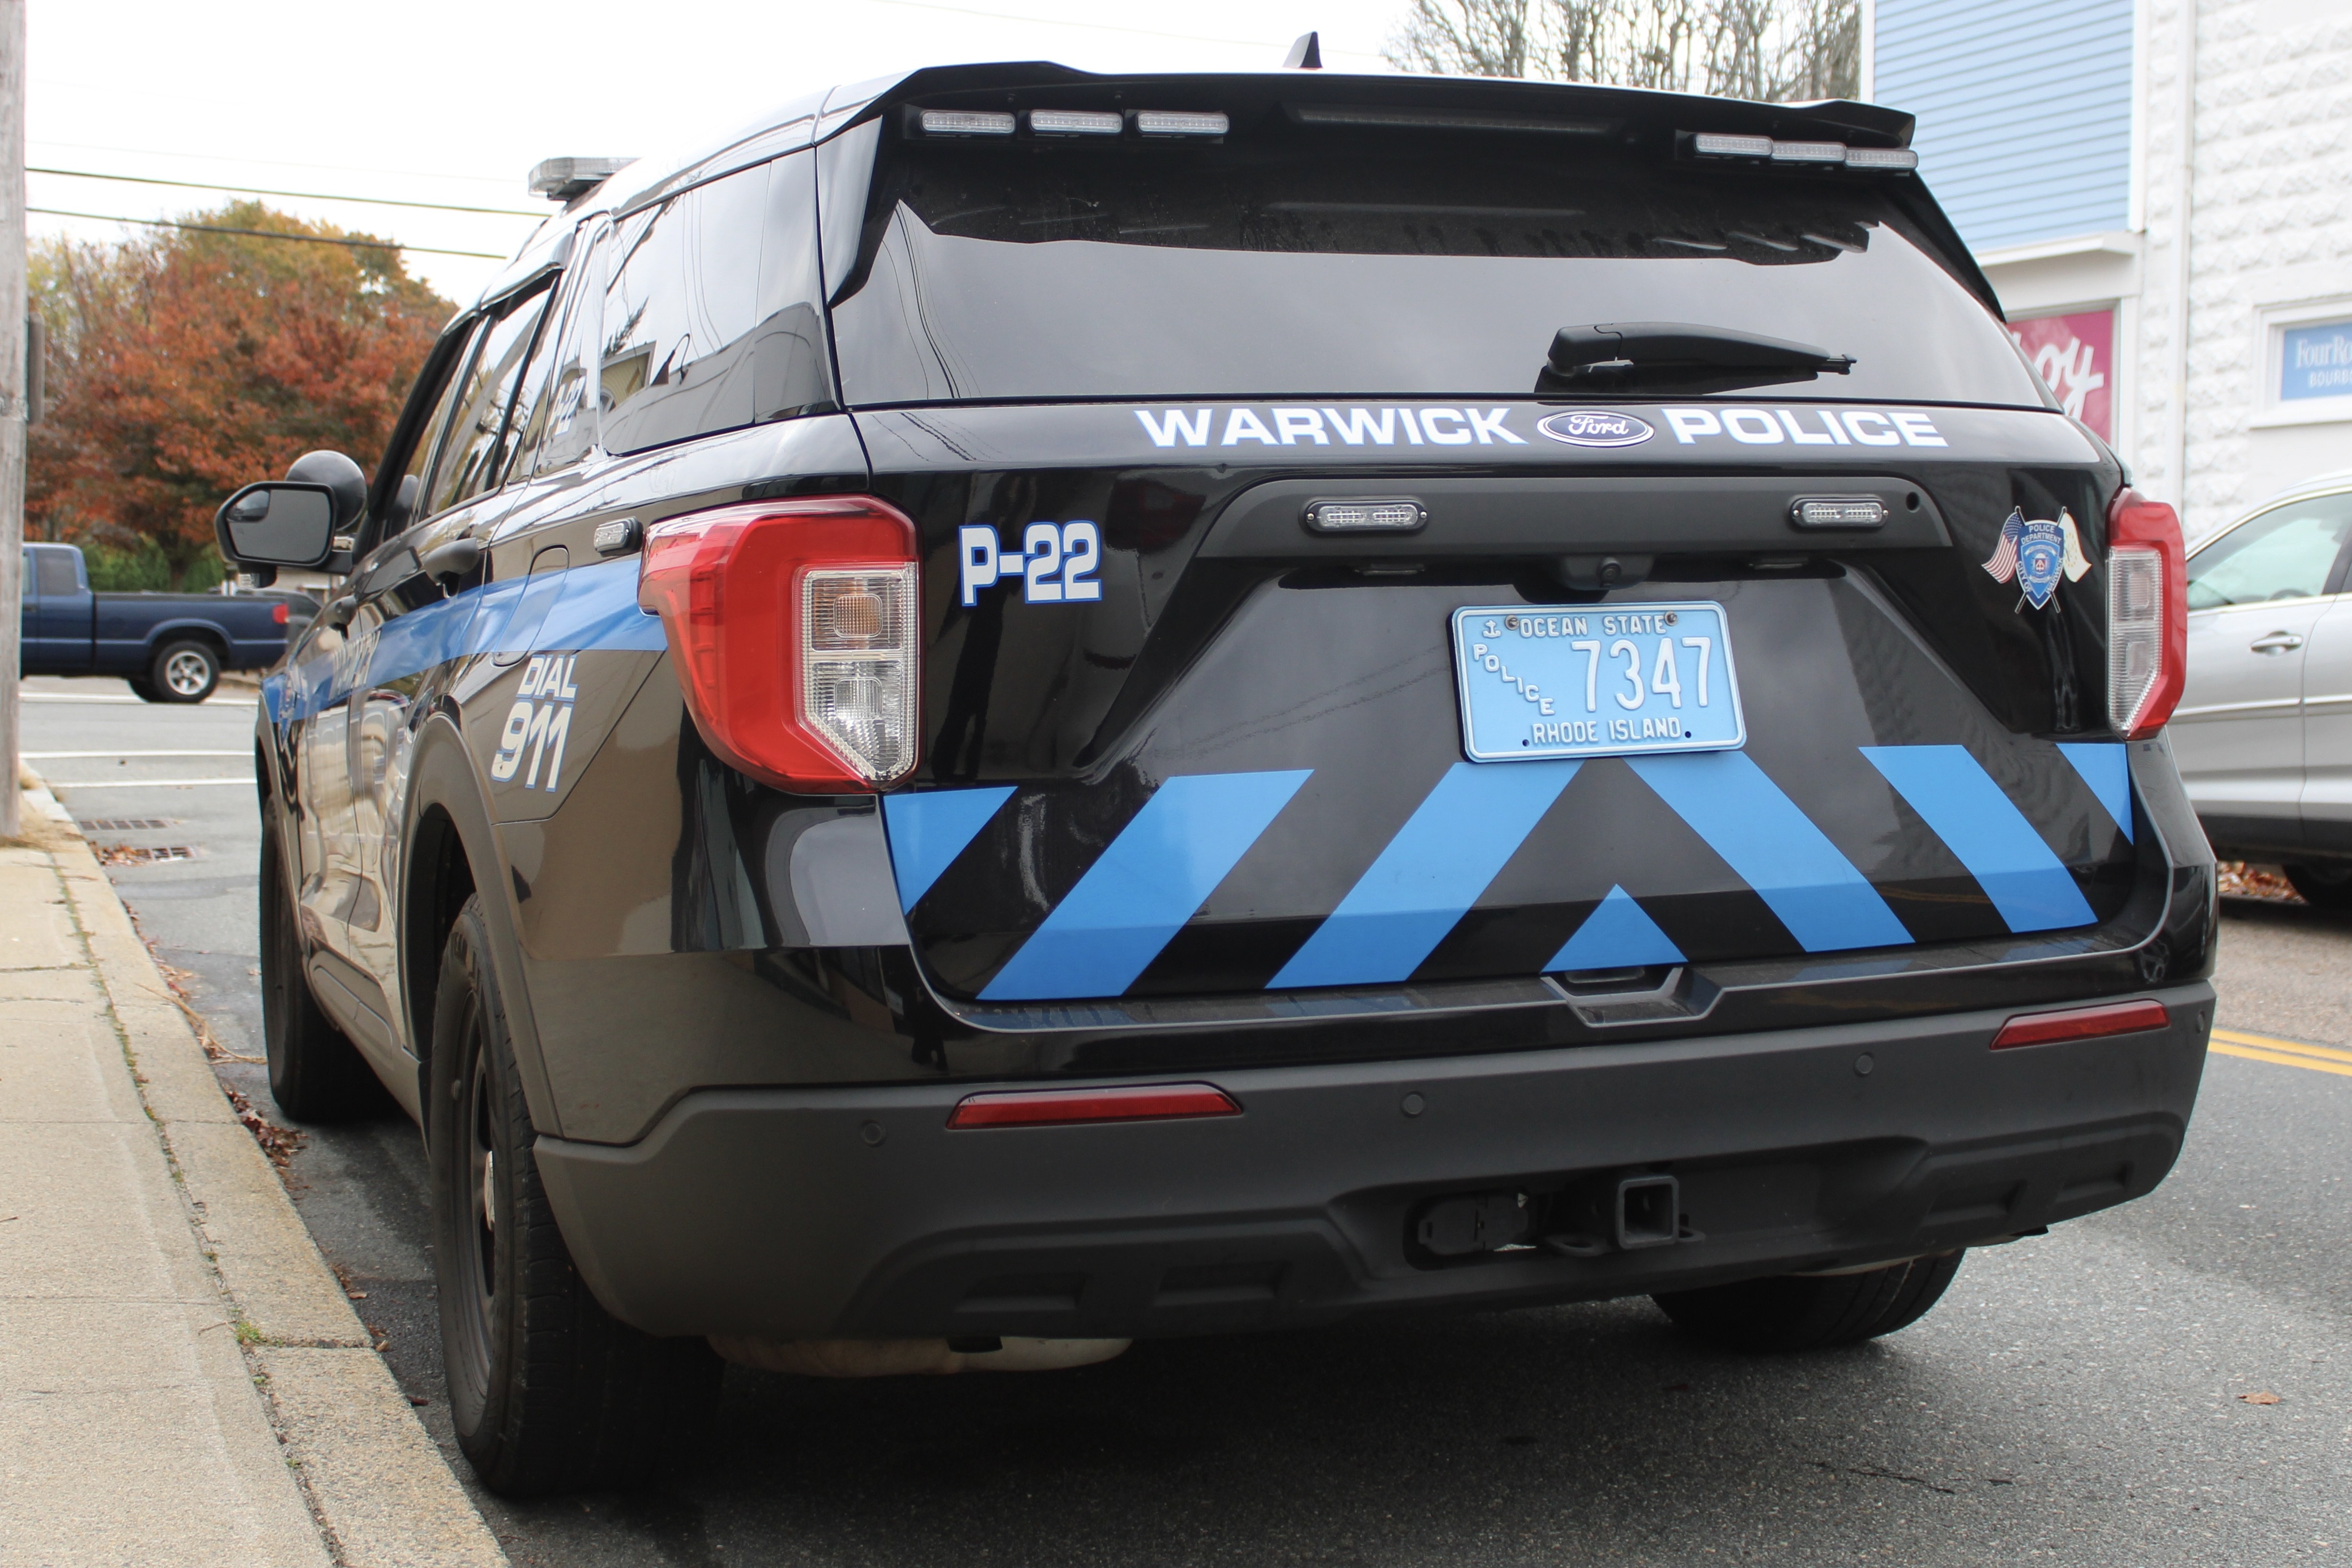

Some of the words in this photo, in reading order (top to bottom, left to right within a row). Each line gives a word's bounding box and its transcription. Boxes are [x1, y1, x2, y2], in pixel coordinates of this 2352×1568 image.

[2297, 338, 2333, 367] Four
[1134, 408, 1529, 447] WARWICK
[1661, 408, 1949, 447] POLICE
[1568, 415, 1630, 435] Ford
[2021, 532, 2062, 545] DEPARTMENT
[2029, 524, 2055, 533] POLICE
[959, 520, 1102, 607] P-22
[2017, 561, 2027, 580] CITY
[2045, 557, 2064, 594] WARWICK
[1519, 617, 1588, 638] OCEAN
[1603, 615, 1667, 635] STATE
[516, 654, 578, 702] DIAL
[1473, 643, 1555, 715] POLICE
[1571, 636, 1711, 712] 7347
[490, 698, 574, 792] 911
[1532, 720, 1599, 744] RHODE
[1609, 717, 1682, 740] ISLAND
